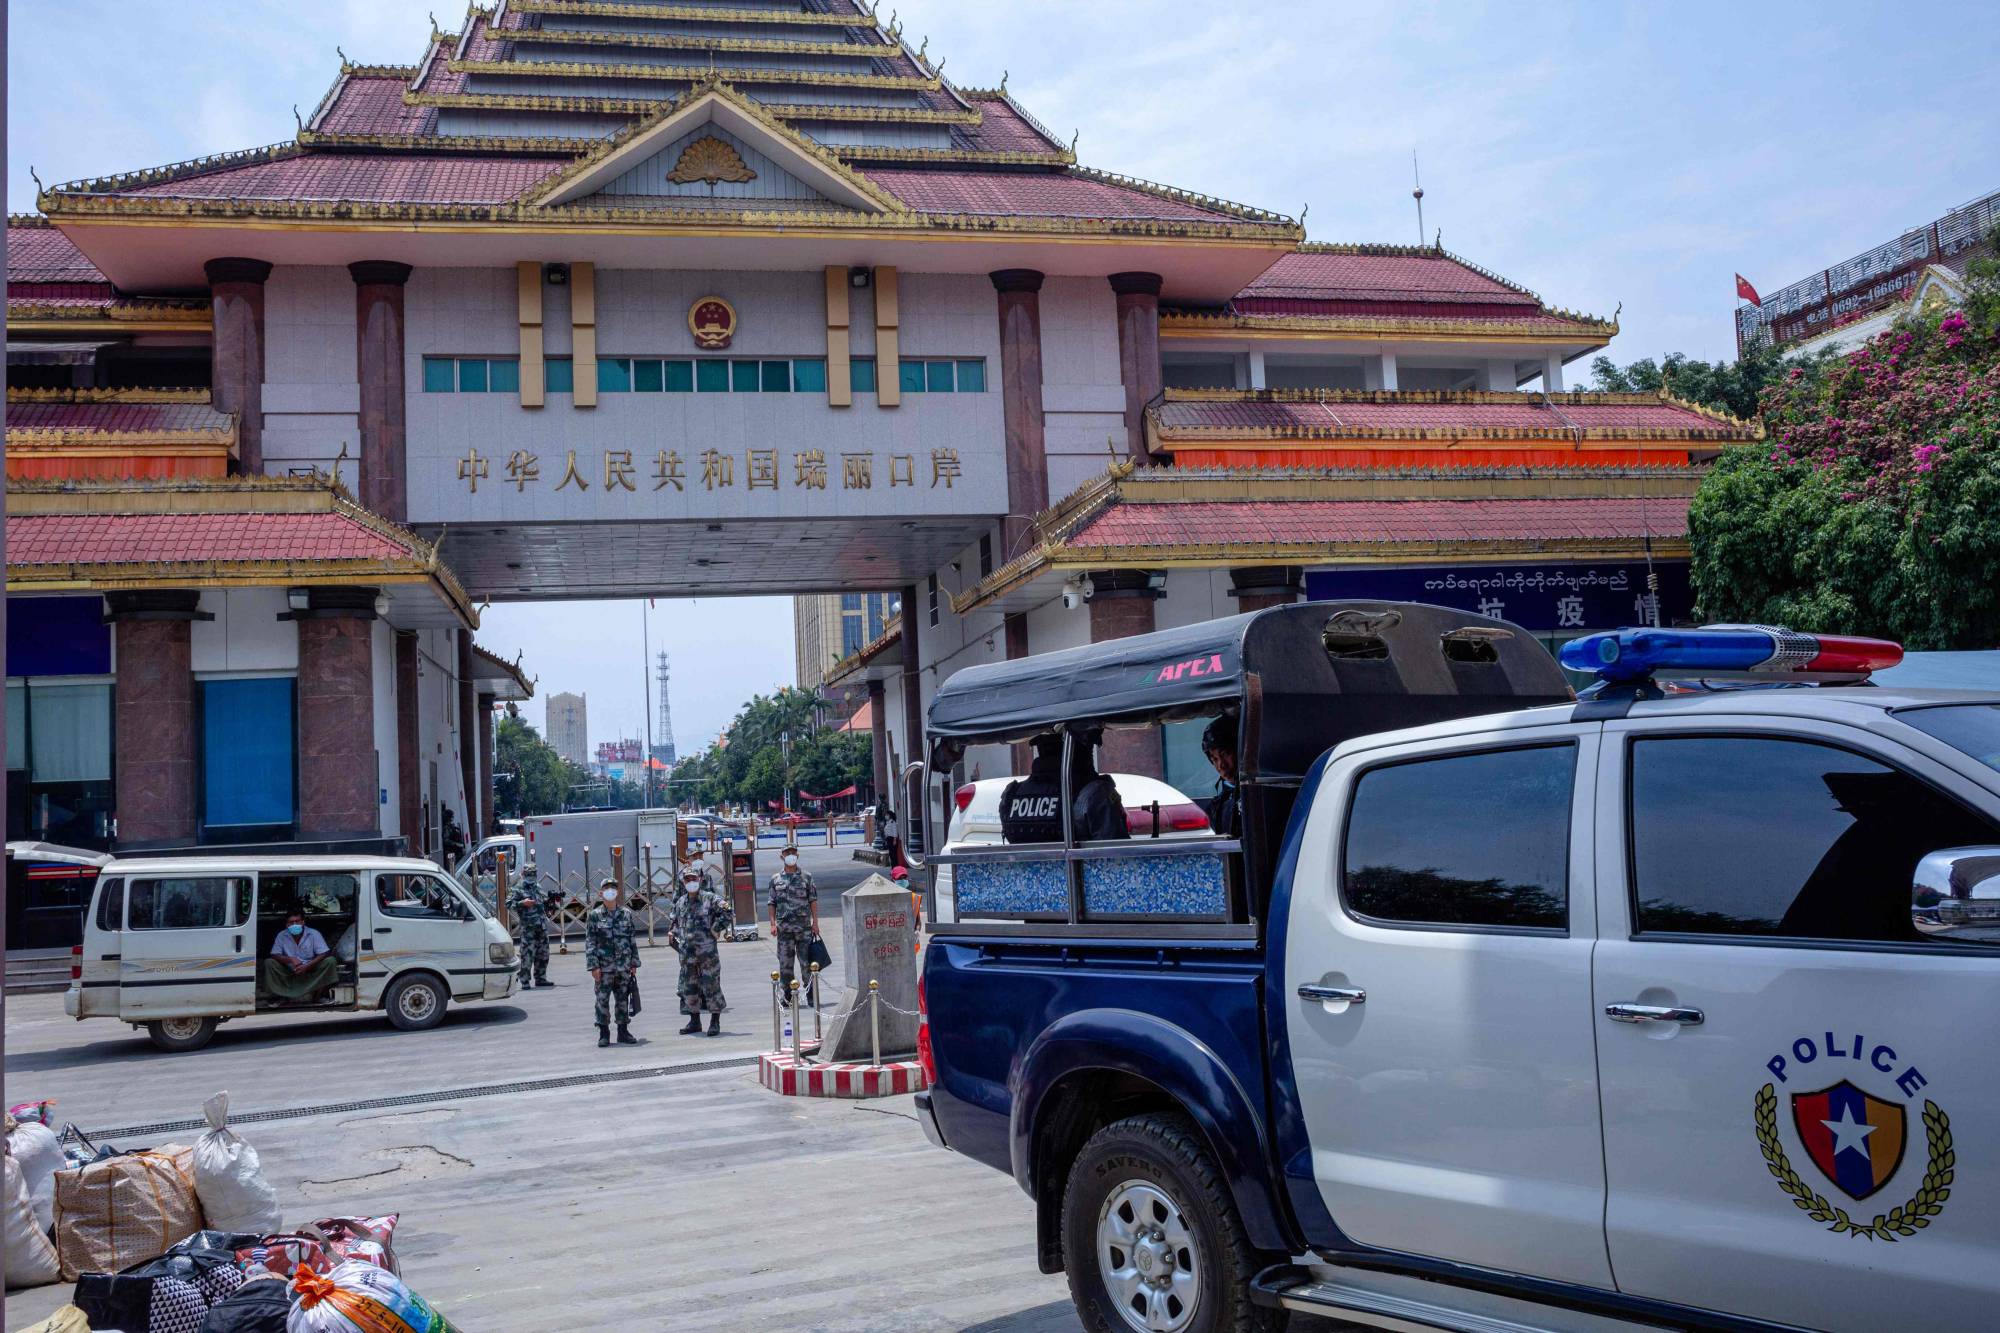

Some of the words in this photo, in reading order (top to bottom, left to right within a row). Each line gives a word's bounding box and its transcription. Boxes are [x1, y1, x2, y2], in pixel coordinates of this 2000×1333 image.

[457, 448, 963, 493] 中华人民共和国瑞丽口岸
[1010, 797, 1059, 818] POLICE
[1766, 1031, 1928, 1098] POLICE
